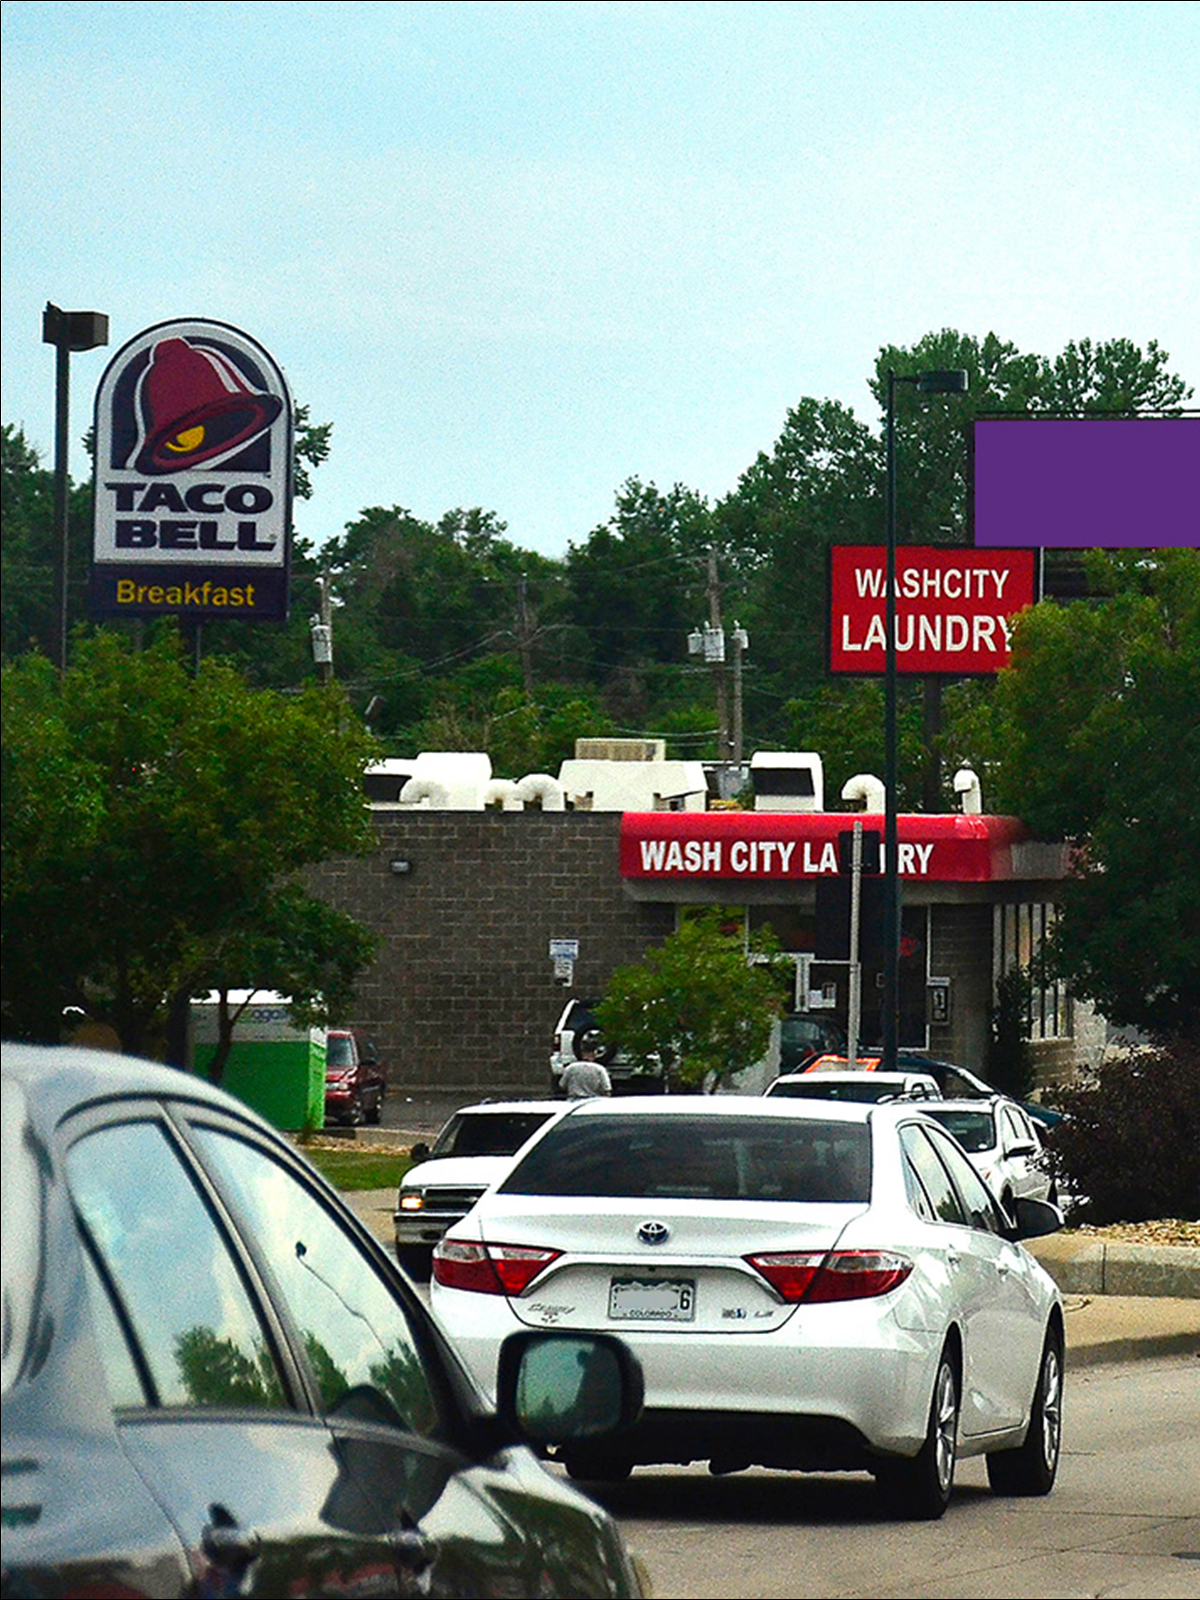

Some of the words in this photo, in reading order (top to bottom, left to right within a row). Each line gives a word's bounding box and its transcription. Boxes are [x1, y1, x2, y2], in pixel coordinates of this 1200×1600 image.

[105, 483, 273, 514] TACO
[115, 520, 276, 550] BELL
[116, 580, 255, 607] Breakfast
[640, 840, 722, 872] WASH
[730, 841, 796, 873] CITY
[803, 841, 935, 874] LARY
